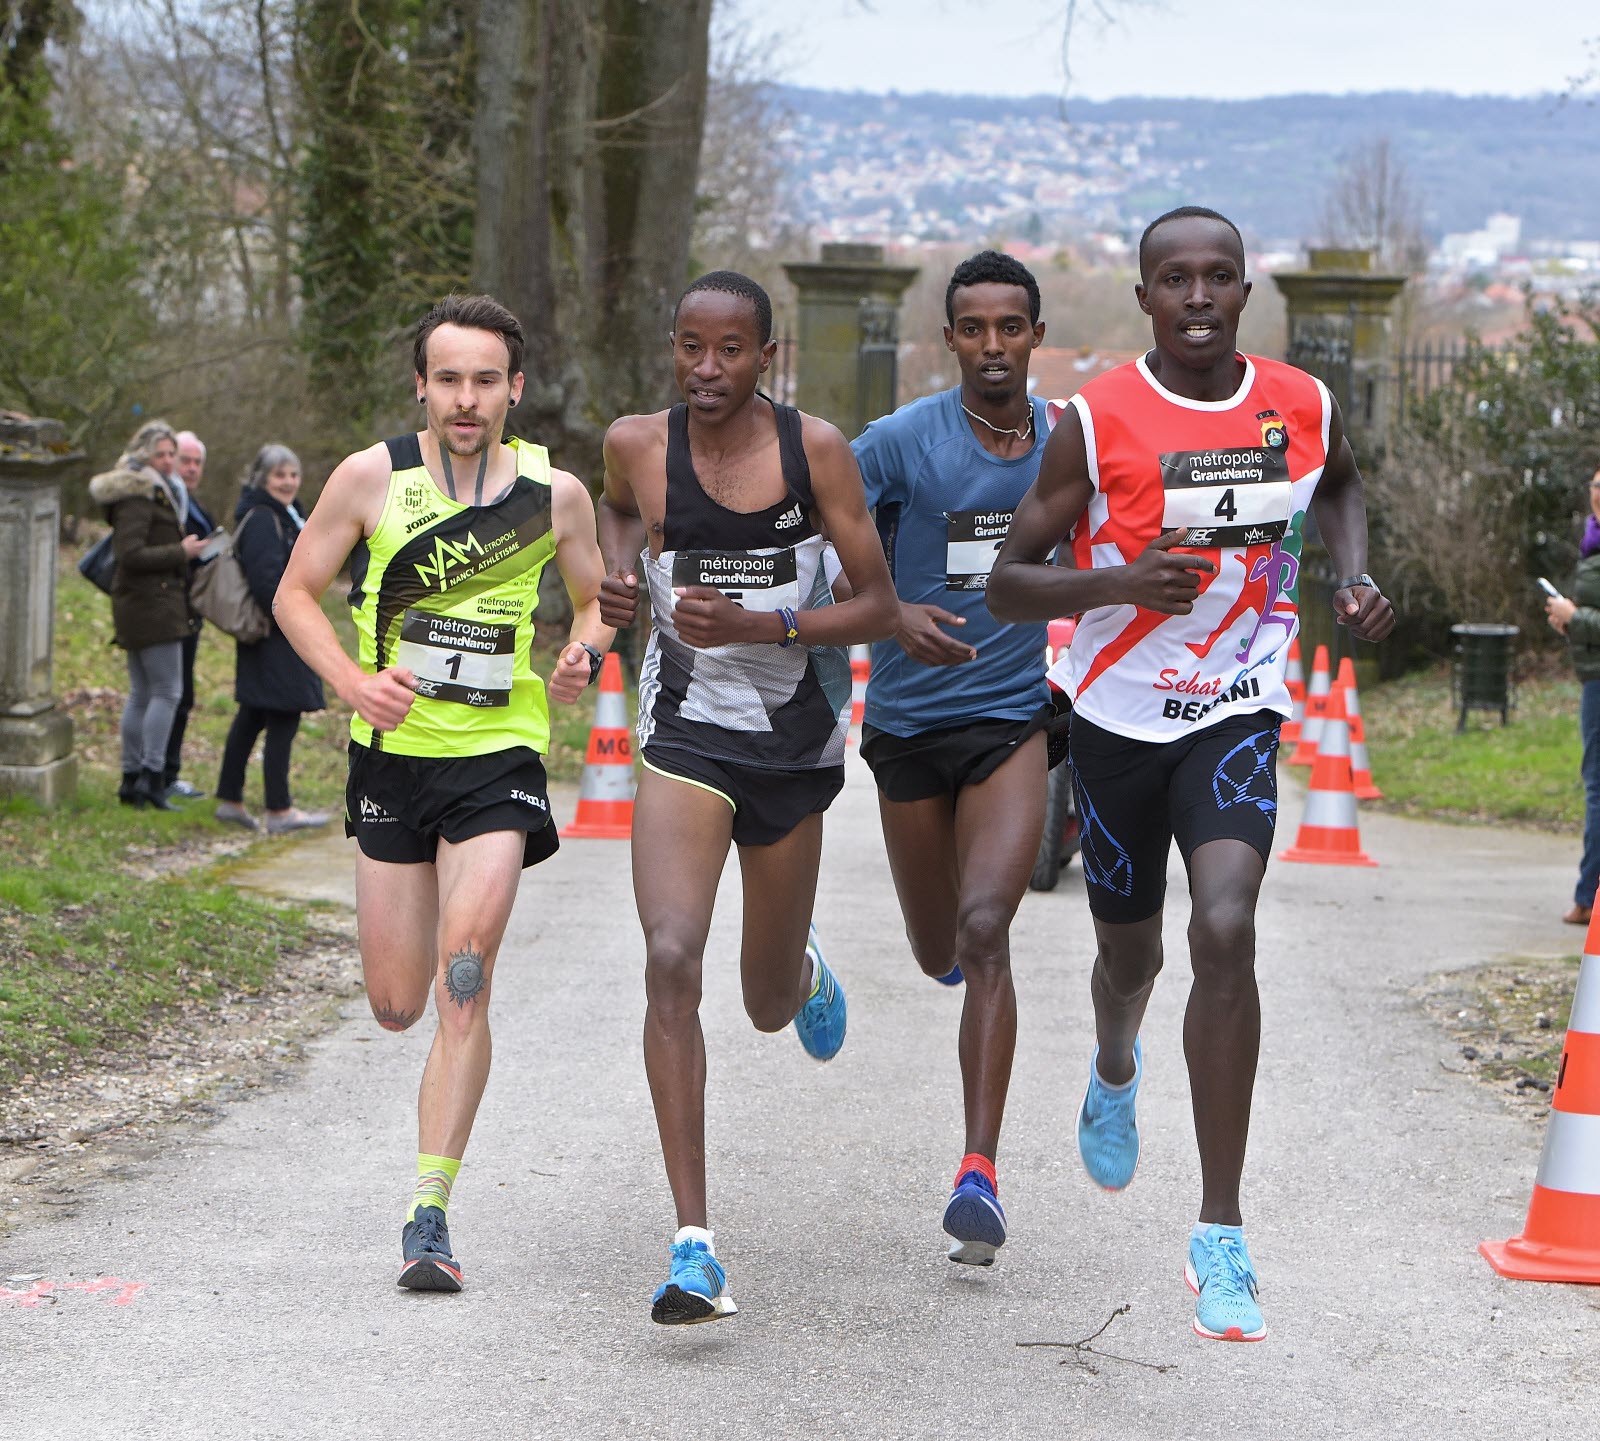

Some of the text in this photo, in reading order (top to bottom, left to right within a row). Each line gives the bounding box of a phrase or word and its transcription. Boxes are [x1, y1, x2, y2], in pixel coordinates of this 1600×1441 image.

[1189, 449, 1263, 468] métropole
[1191, 467, 1263, 482] GrandNancy
[405, 487, 422, 498] Get
[405, 497, 422, 509] Up!
[1214, 488, 1238, 522] 4
[413, 530, 486, 594] NAM
[449, 541, 520, 587] NANCY ATHLÉTISME
[700, 556, 774, 573] métropole
[700, 571, 774, 587] GrandNancy
[477, 597, 524, 609] métropole
[477, 607, 523, 619] GrandNancy
[430, 618, 500, 638] métropole
[428, 631, 497, 654] GrandNancy
[445, 653, 462, 681] 1
[1153, 668, 1222, 696] Sehat
